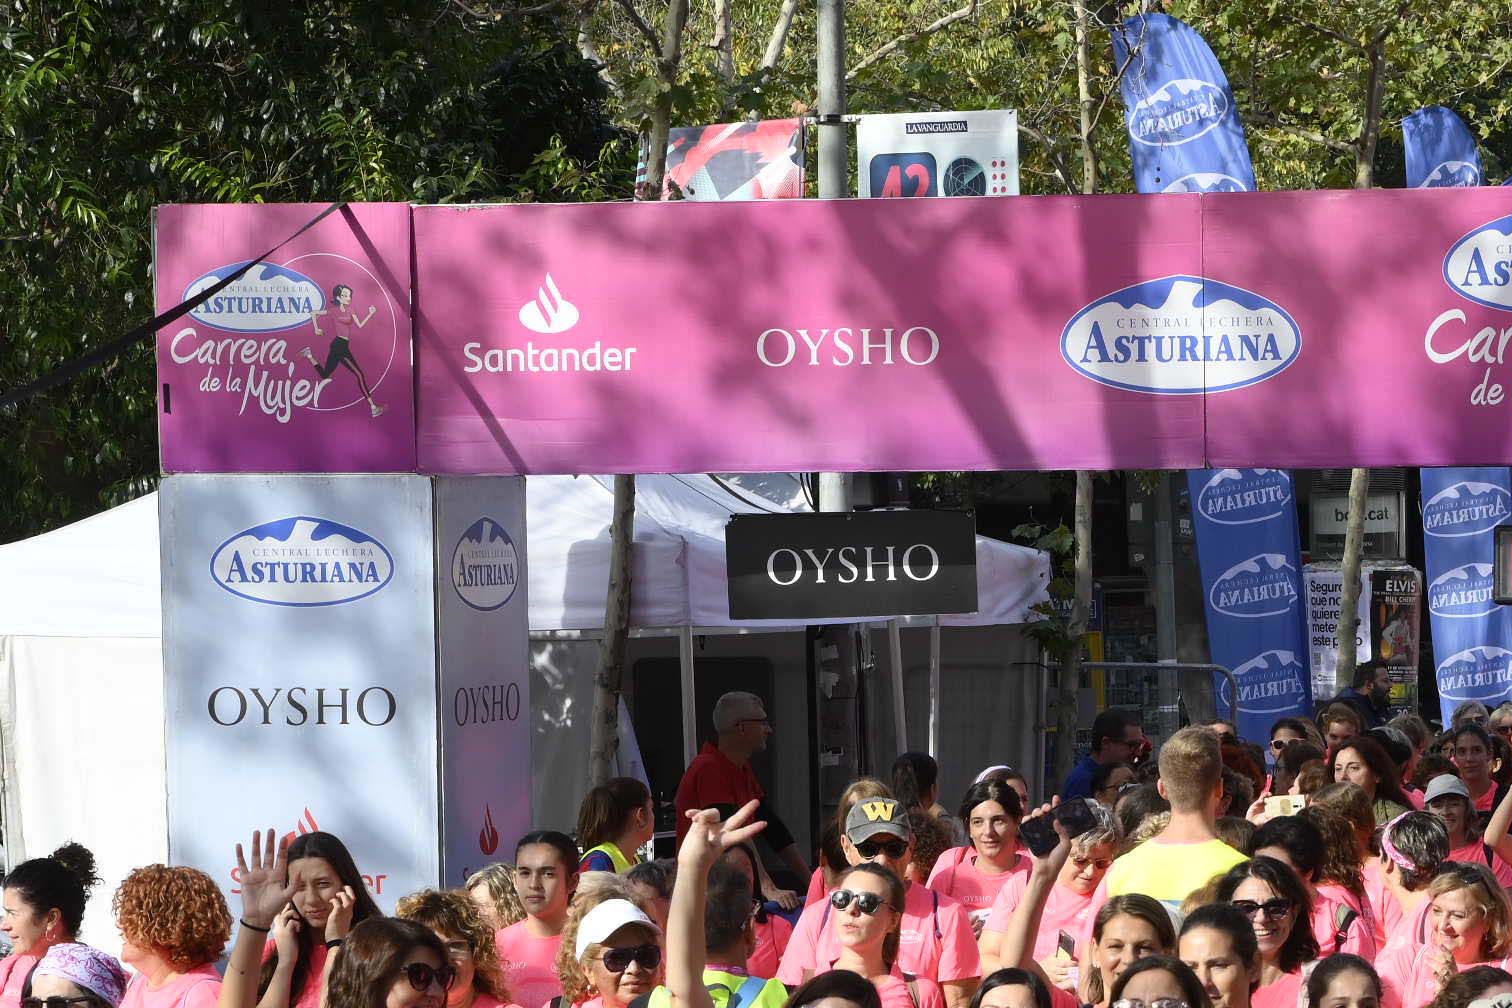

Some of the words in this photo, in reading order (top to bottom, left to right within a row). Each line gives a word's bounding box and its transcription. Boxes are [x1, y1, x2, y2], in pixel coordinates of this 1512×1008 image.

[194, 288, 313, 314] ASTURIANA
[219, 285, 260, 293] ENTRAL
[1116, 316, 1193, 329] CENTRAL
[170, 327, 288, 365] Carrera
[463, 340, 637, 374] Santander
[756, 326, 941, 368] OYSHO
[1080, 319, 1282, 364] ASTURIANA
[199, 367, 222, 393] de
[226, 366, 241, 393] la
[239, 361, 333, 424] Mujer
[1470, 368, 1504, 407] de
[1335, 506, 1389, 522] b.cat
[225, 550, 381, 584] ASTURIANA
[252, 548, 311, 557] CENTRAL
[314, 548, 374, 557] LECHERA
[766, 543, 940, 586] OYSHO
[458, 553, 515, 588] ASTURIANA
[1386, 580, 1416, 592] ELVIS
[1311, 608, 1343, 620] quiere
[1312, 634, 1331, 647] este
[207, 686, 397, 727] OYSHO
[454, 682, 520, 728] OYSHO
[861, 802, 895, 822] W
